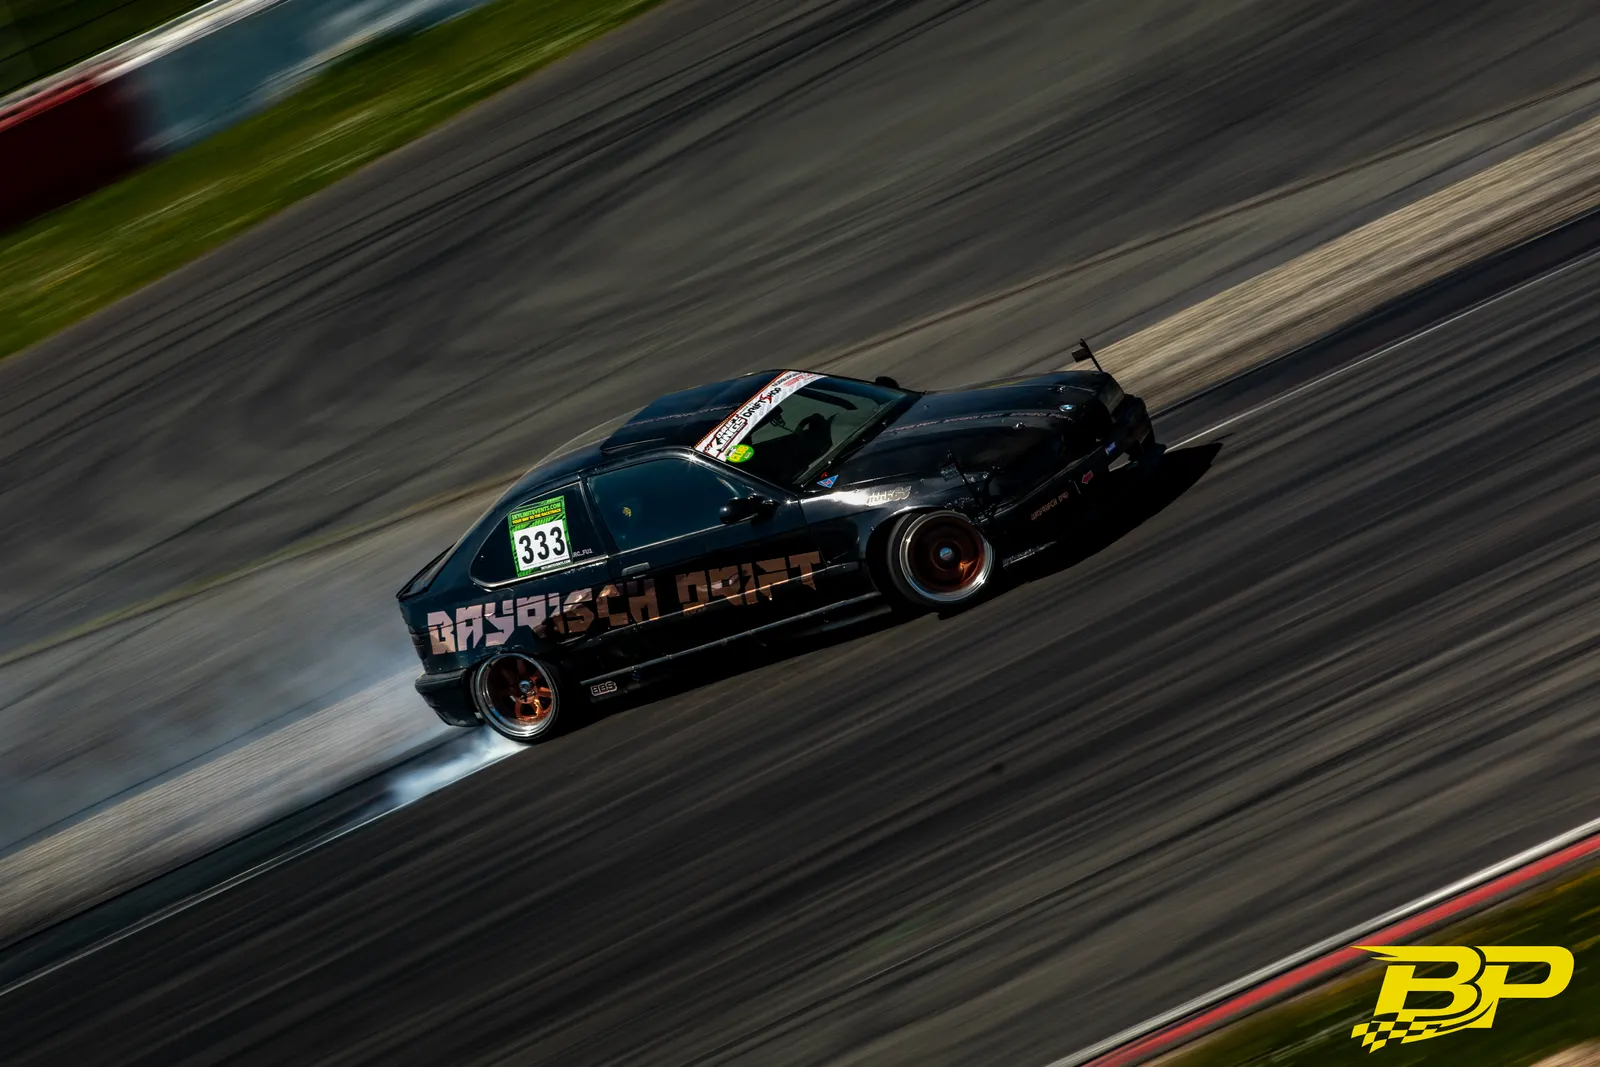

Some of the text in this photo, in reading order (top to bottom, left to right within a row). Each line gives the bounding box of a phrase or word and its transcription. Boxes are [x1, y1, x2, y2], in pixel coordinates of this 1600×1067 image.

[708, 417, 746, 454] KINGS
[716, 414, 740, 439] DRIFT
[519, 526, 566, 564] 333
[427, 551, 821, 656] BAYRISCH DRIFT
[590, 681, 618, 697] BBS
